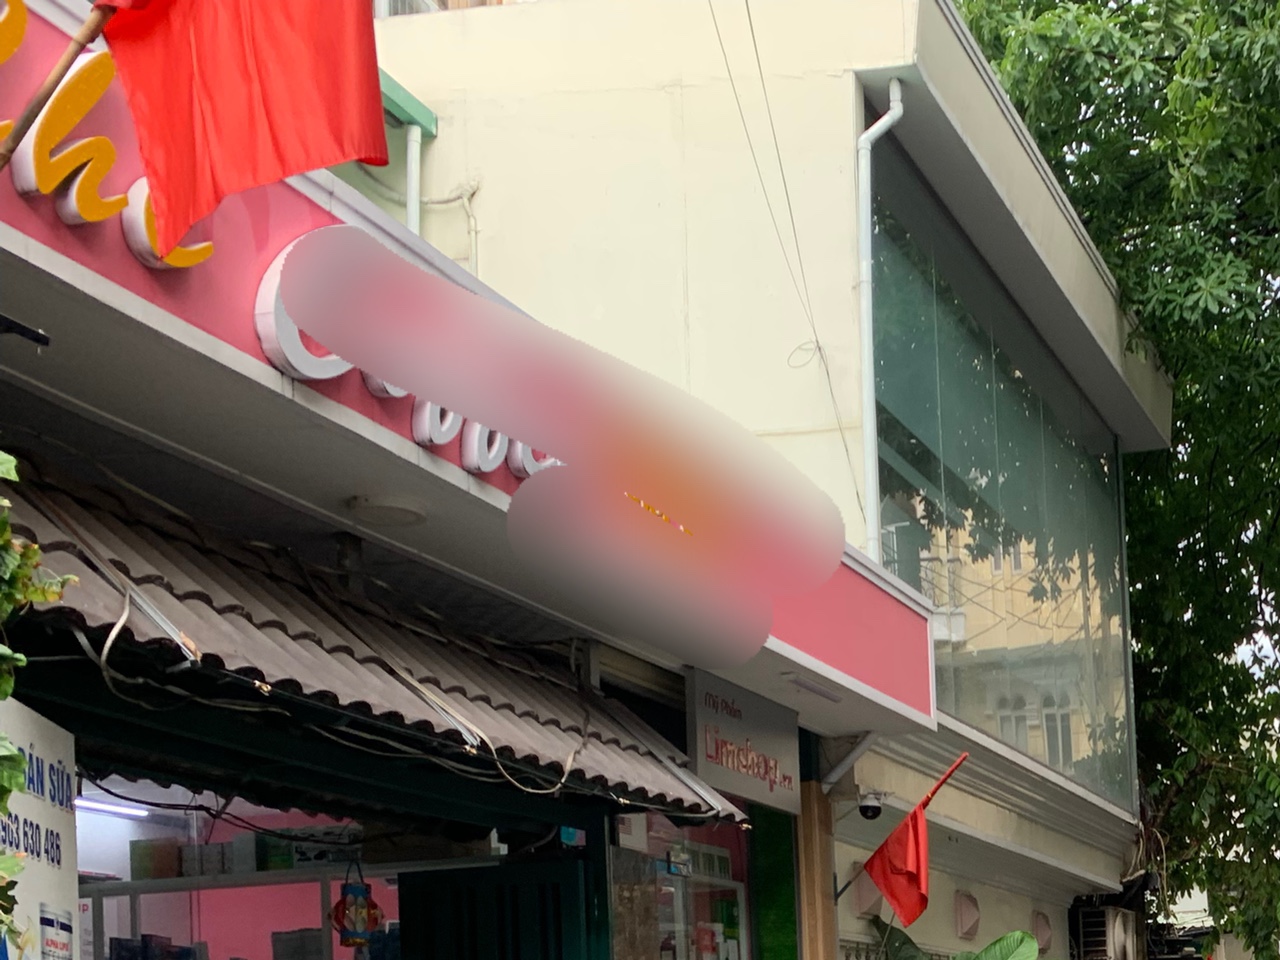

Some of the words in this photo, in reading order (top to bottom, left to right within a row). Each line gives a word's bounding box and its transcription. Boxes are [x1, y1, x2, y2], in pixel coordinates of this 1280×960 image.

[49, 760, 73, 811] SỮA
[23, 818, 41, 859] 630
[44, 827, 61, 867] 486
